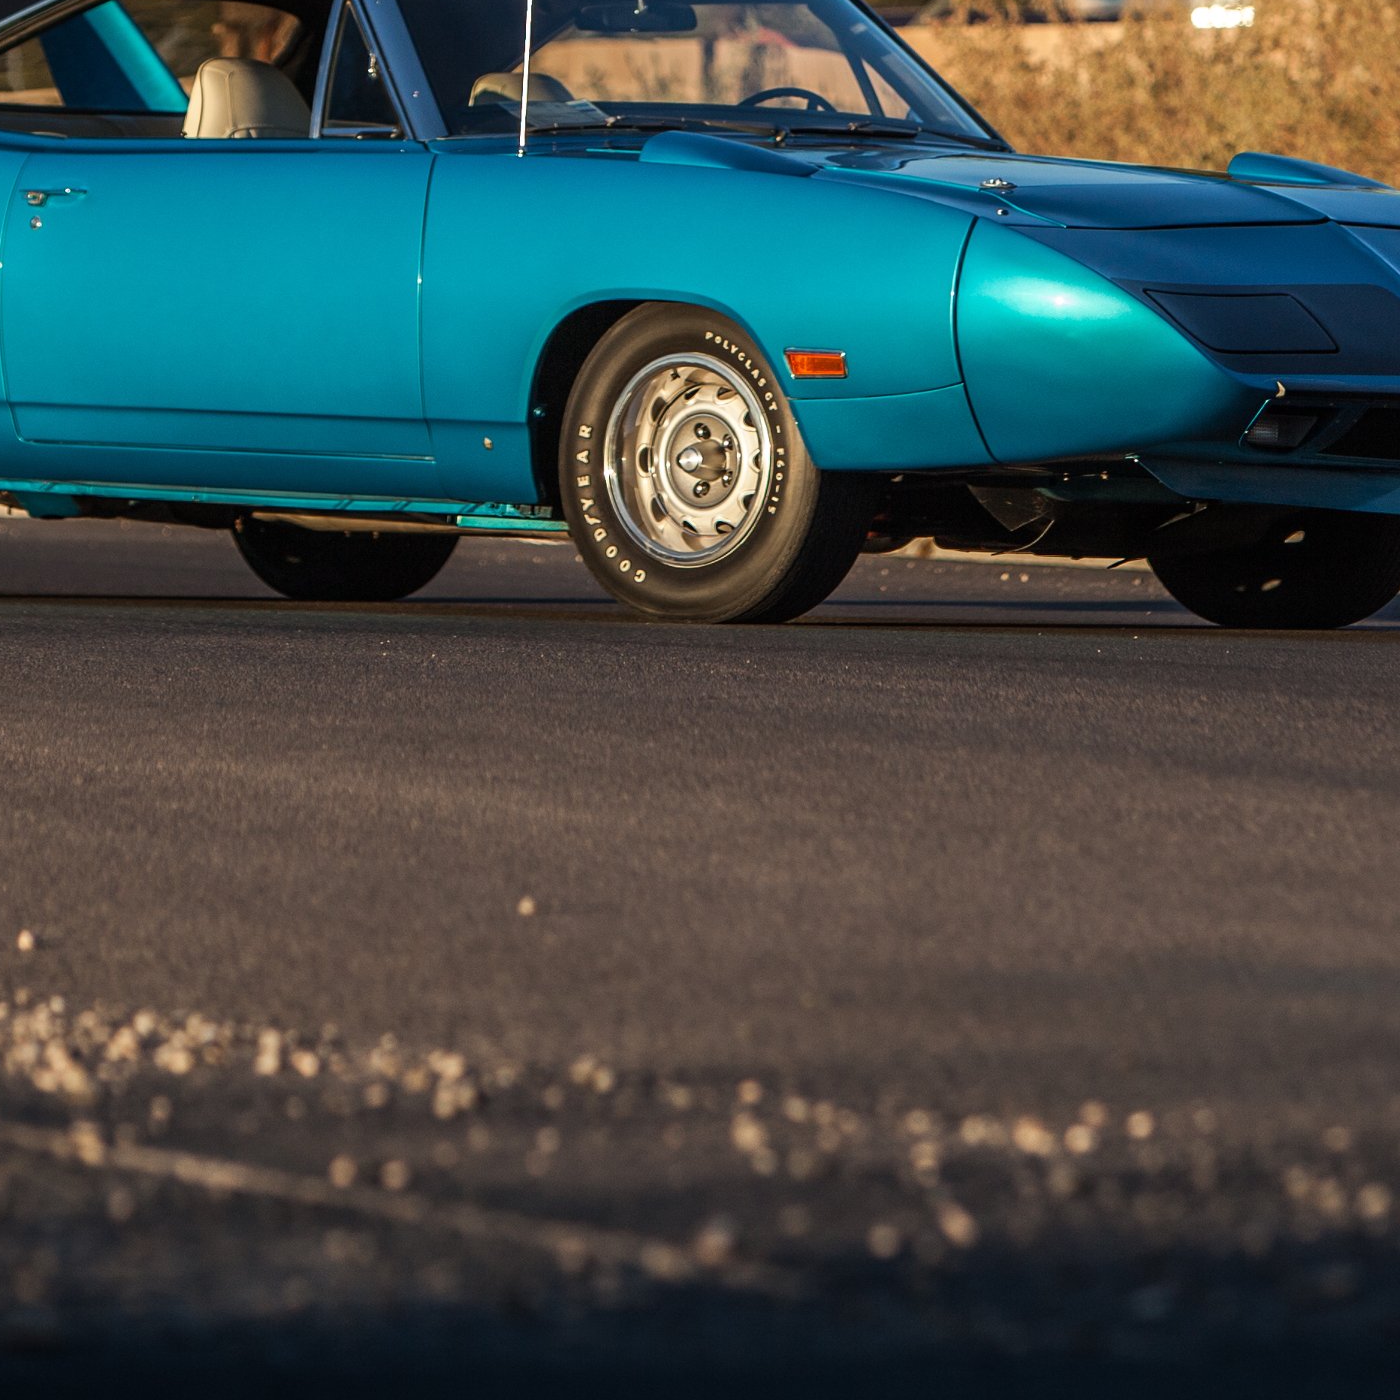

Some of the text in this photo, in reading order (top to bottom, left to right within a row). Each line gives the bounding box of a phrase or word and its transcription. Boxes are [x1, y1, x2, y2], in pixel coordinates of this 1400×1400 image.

[705, 331, 767, 387] POLYGLAS
[764, 392, 777, 411] GT
[576, 424, 646, 583] GOODYEAR
